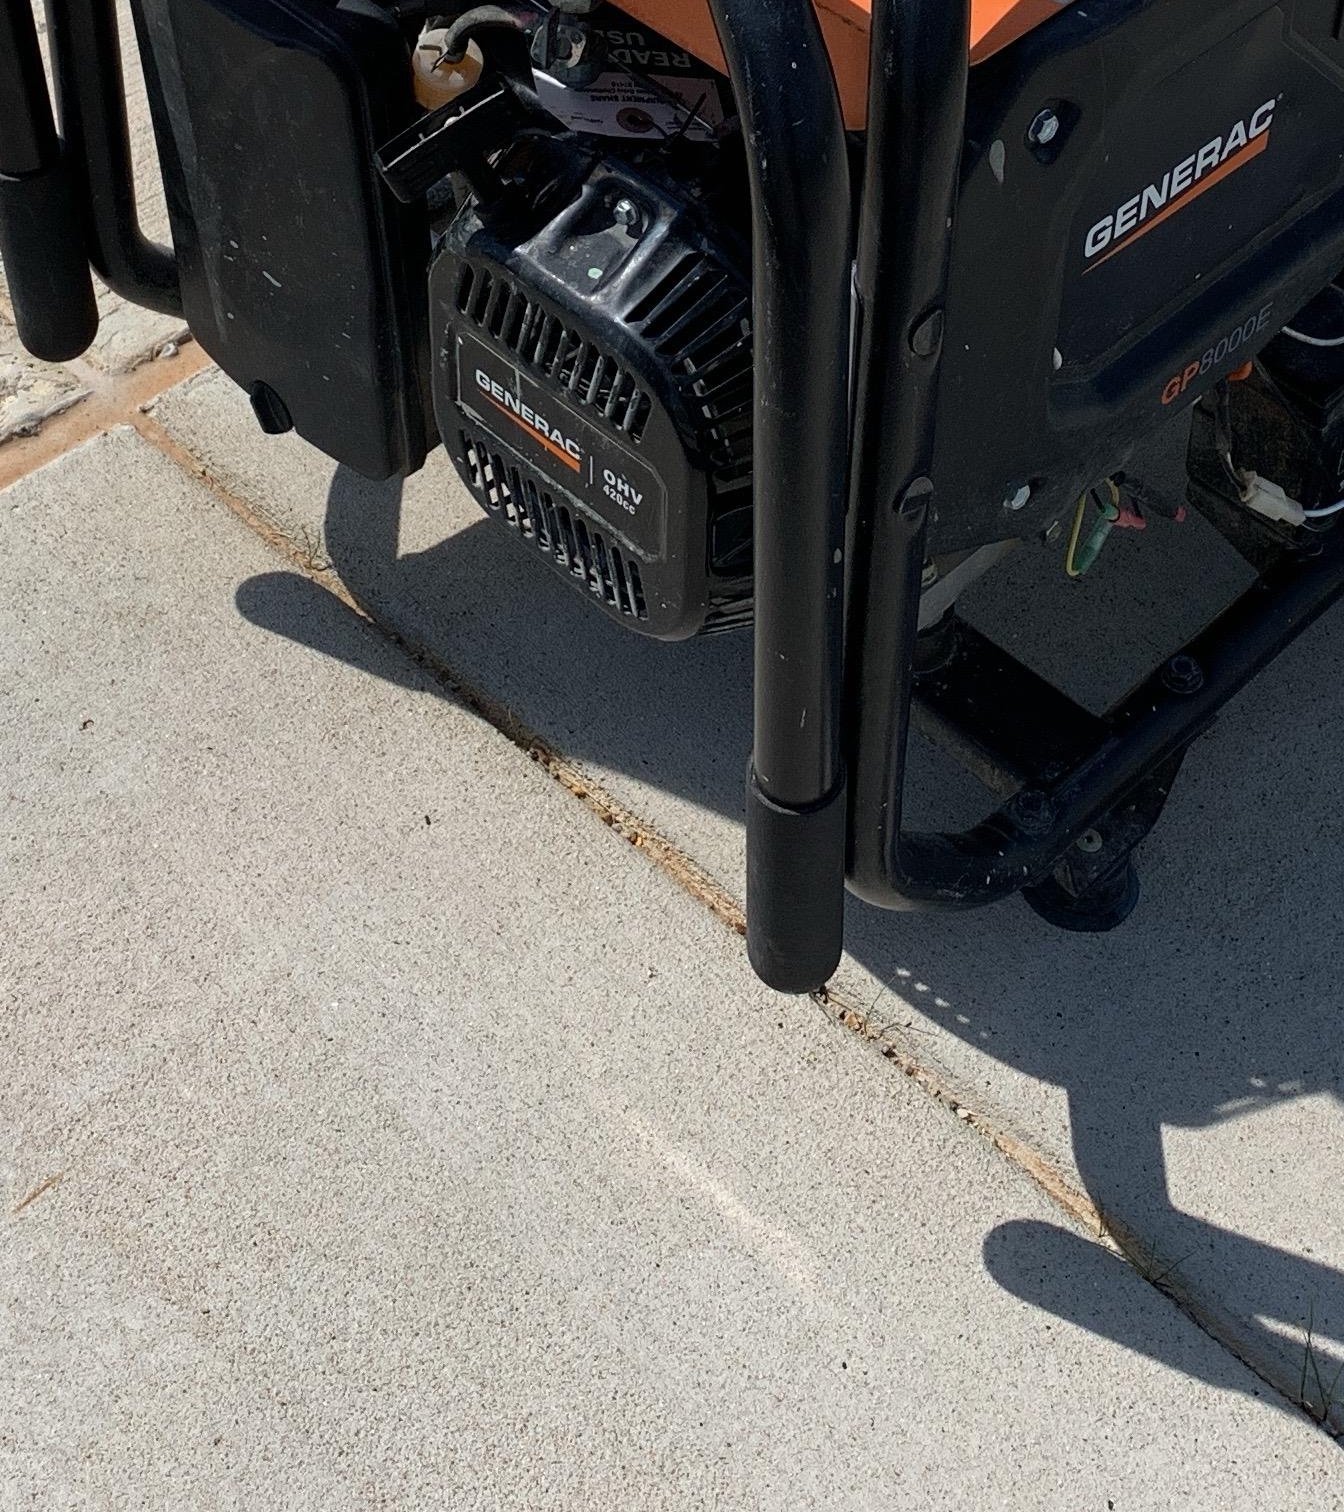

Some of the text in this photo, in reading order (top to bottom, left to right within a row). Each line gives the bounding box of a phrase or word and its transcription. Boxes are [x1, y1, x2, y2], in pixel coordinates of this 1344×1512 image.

[1084, 98, 1276, 258] GENERAC
[1160, 301, 1274, 405] GP8000E
[475, 368, 582, 461] GENERAC
[602, 484, 636, 516] 420cc
[603, 468, 644, 506] OHV
